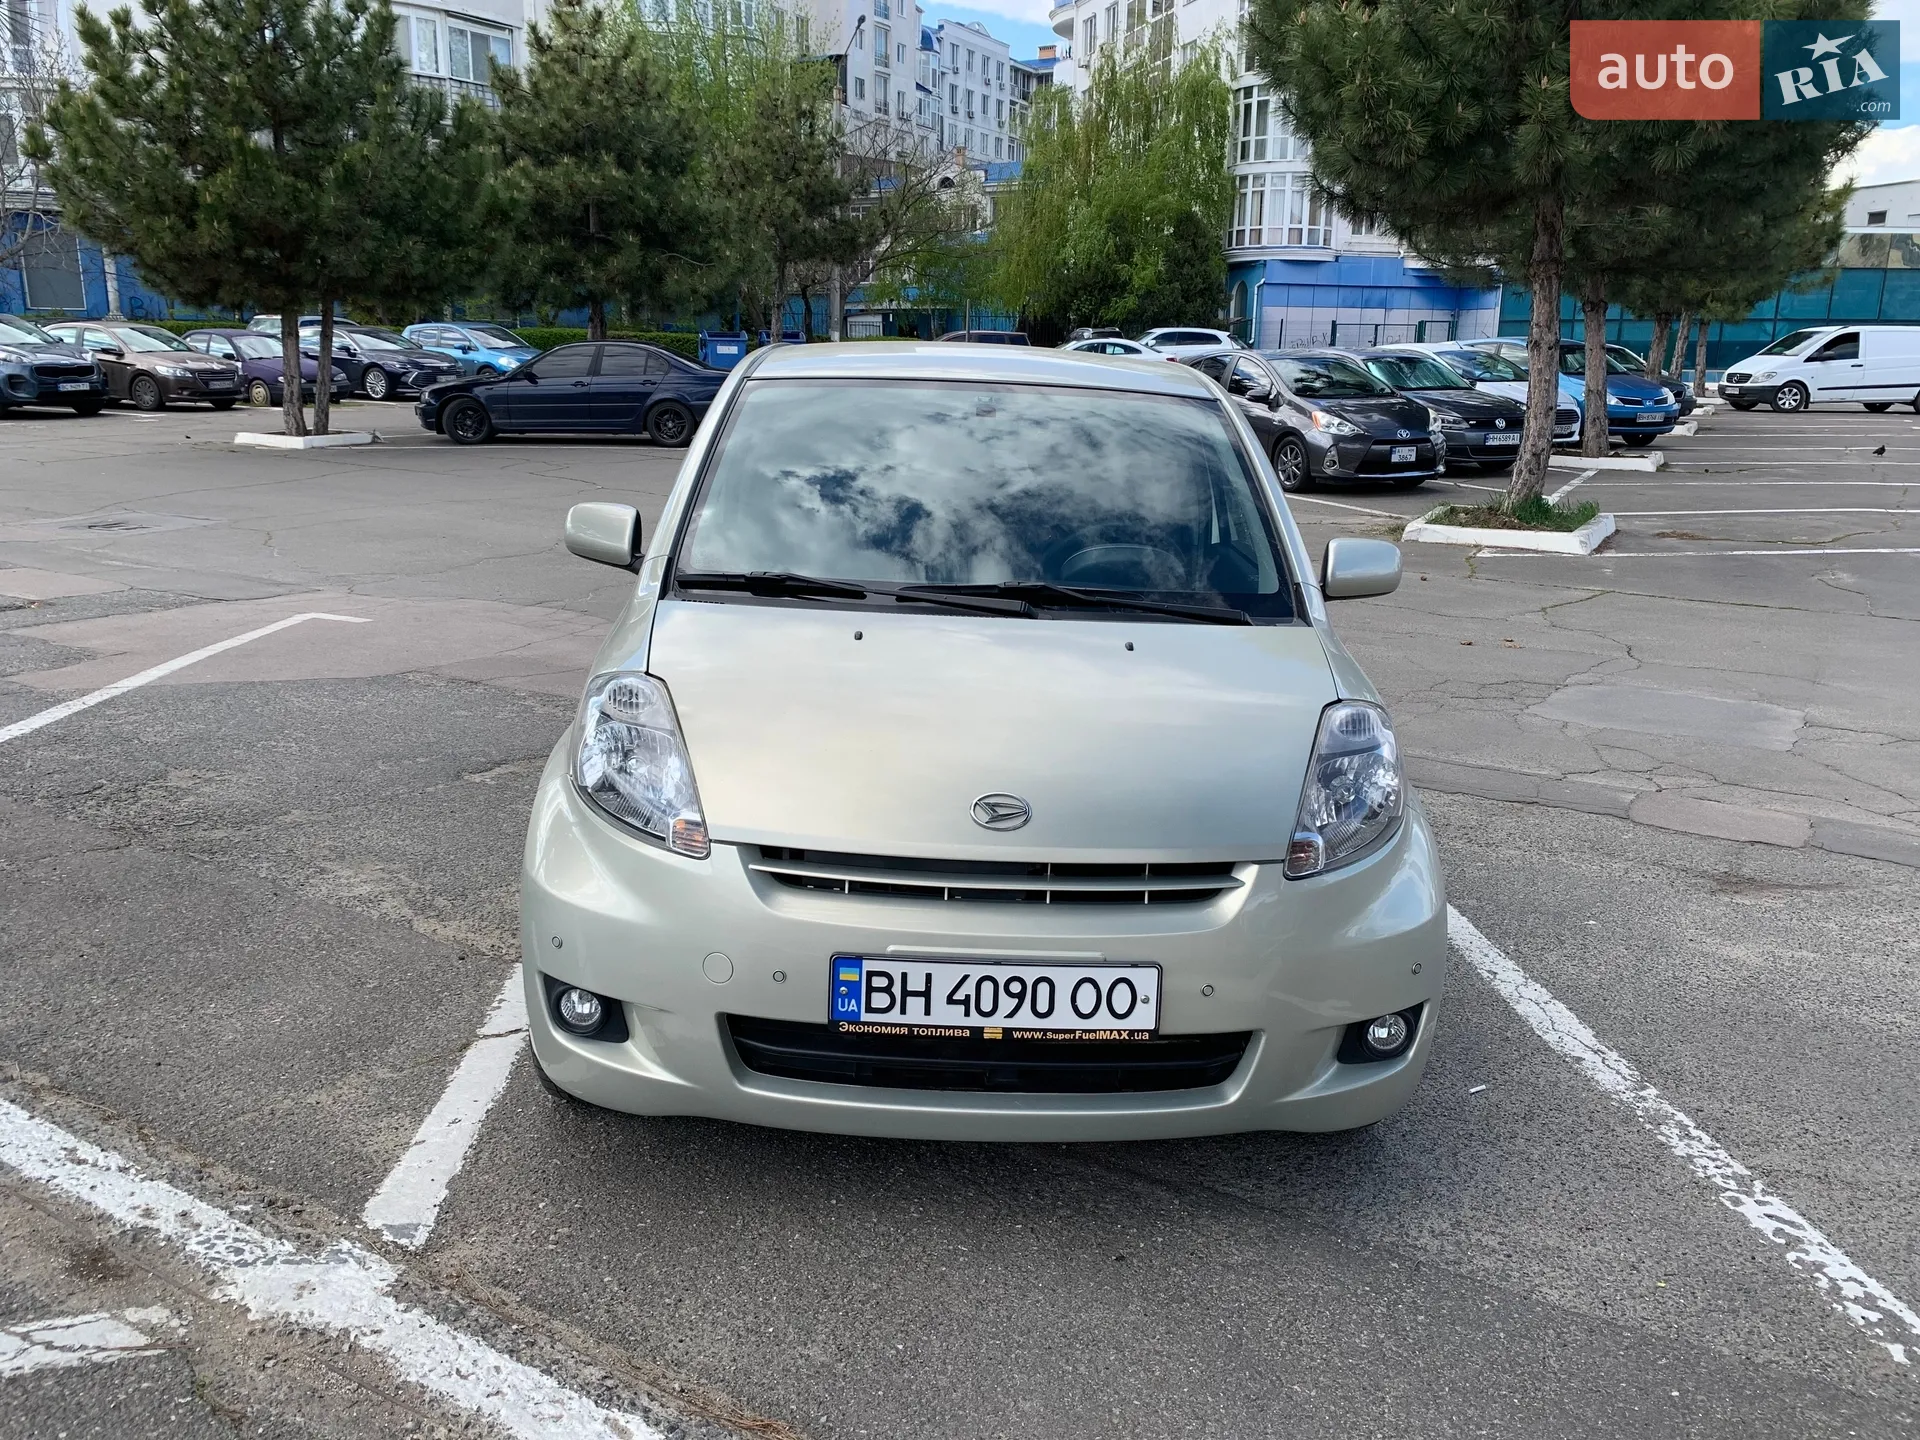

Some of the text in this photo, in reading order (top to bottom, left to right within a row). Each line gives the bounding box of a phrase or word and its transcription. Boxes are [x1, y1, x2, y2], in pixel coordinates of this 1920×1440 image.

[1398, 454, 1413, 462] 3867
[864, 970, 1138, 1020] BH 4090 OO
[837, 998, 858, 1012] UA
[838, 1022, 970, 1038] Экономия топлива
